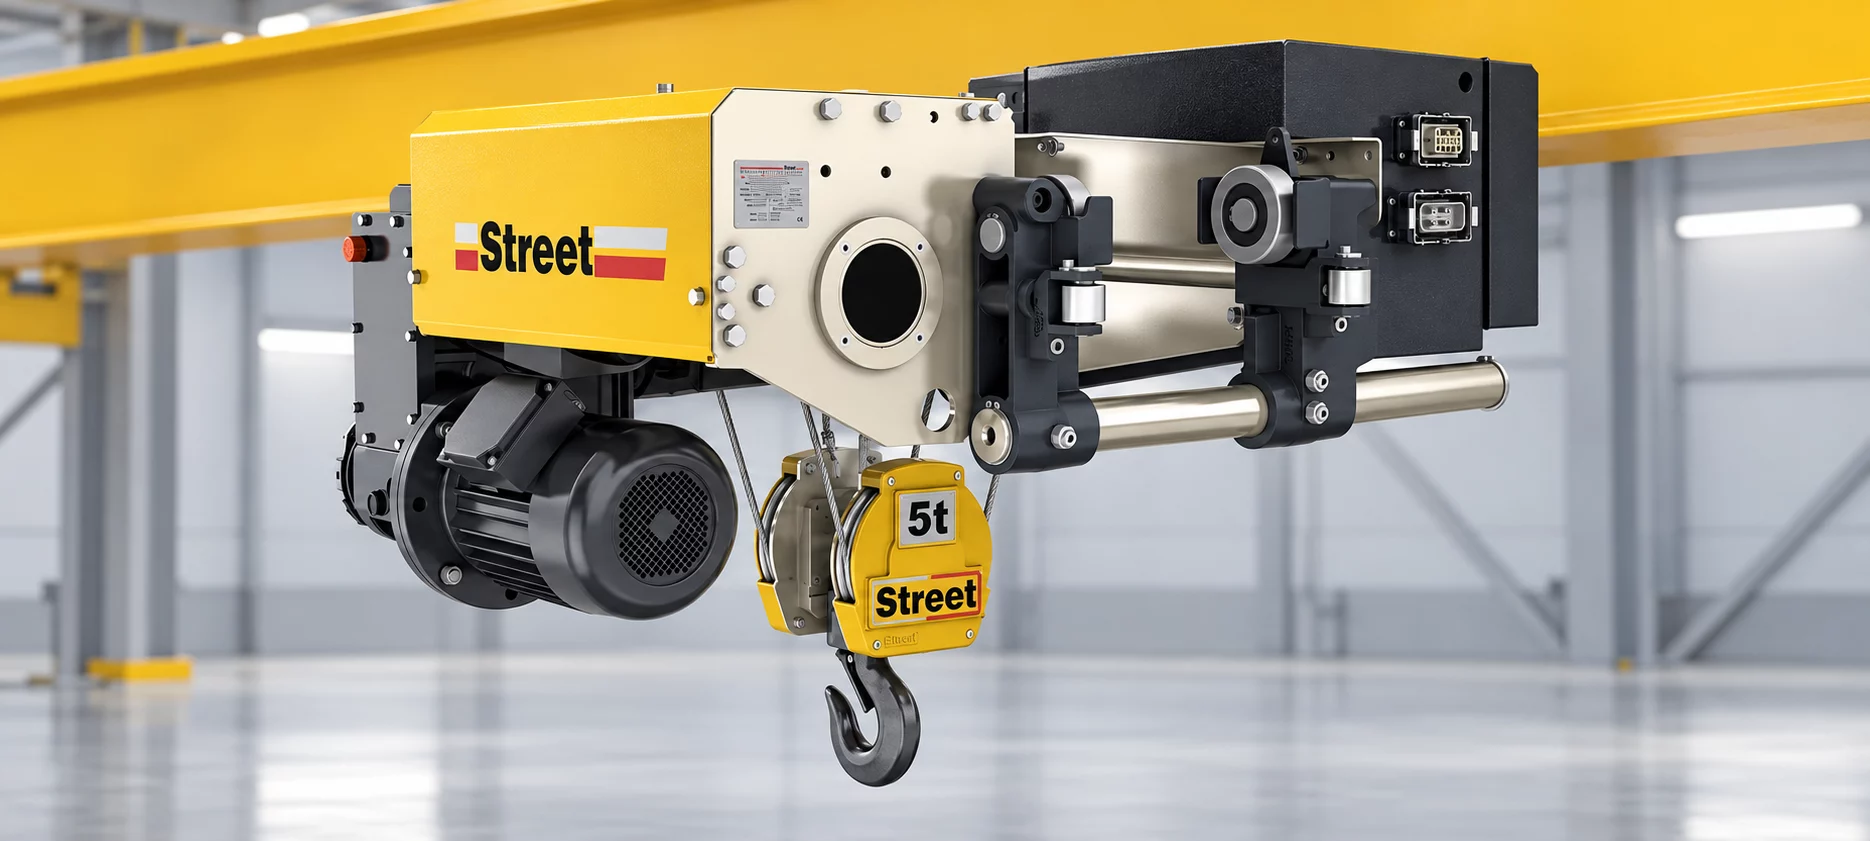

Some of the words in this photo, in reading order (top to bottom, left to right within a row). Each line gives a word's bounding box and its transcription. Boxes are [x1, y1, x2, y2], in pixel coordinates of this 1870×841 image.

[480, 220, 593, 276] Street
[908, 500, 949, 537] 5t
[875, 579, 977, 618] Street
